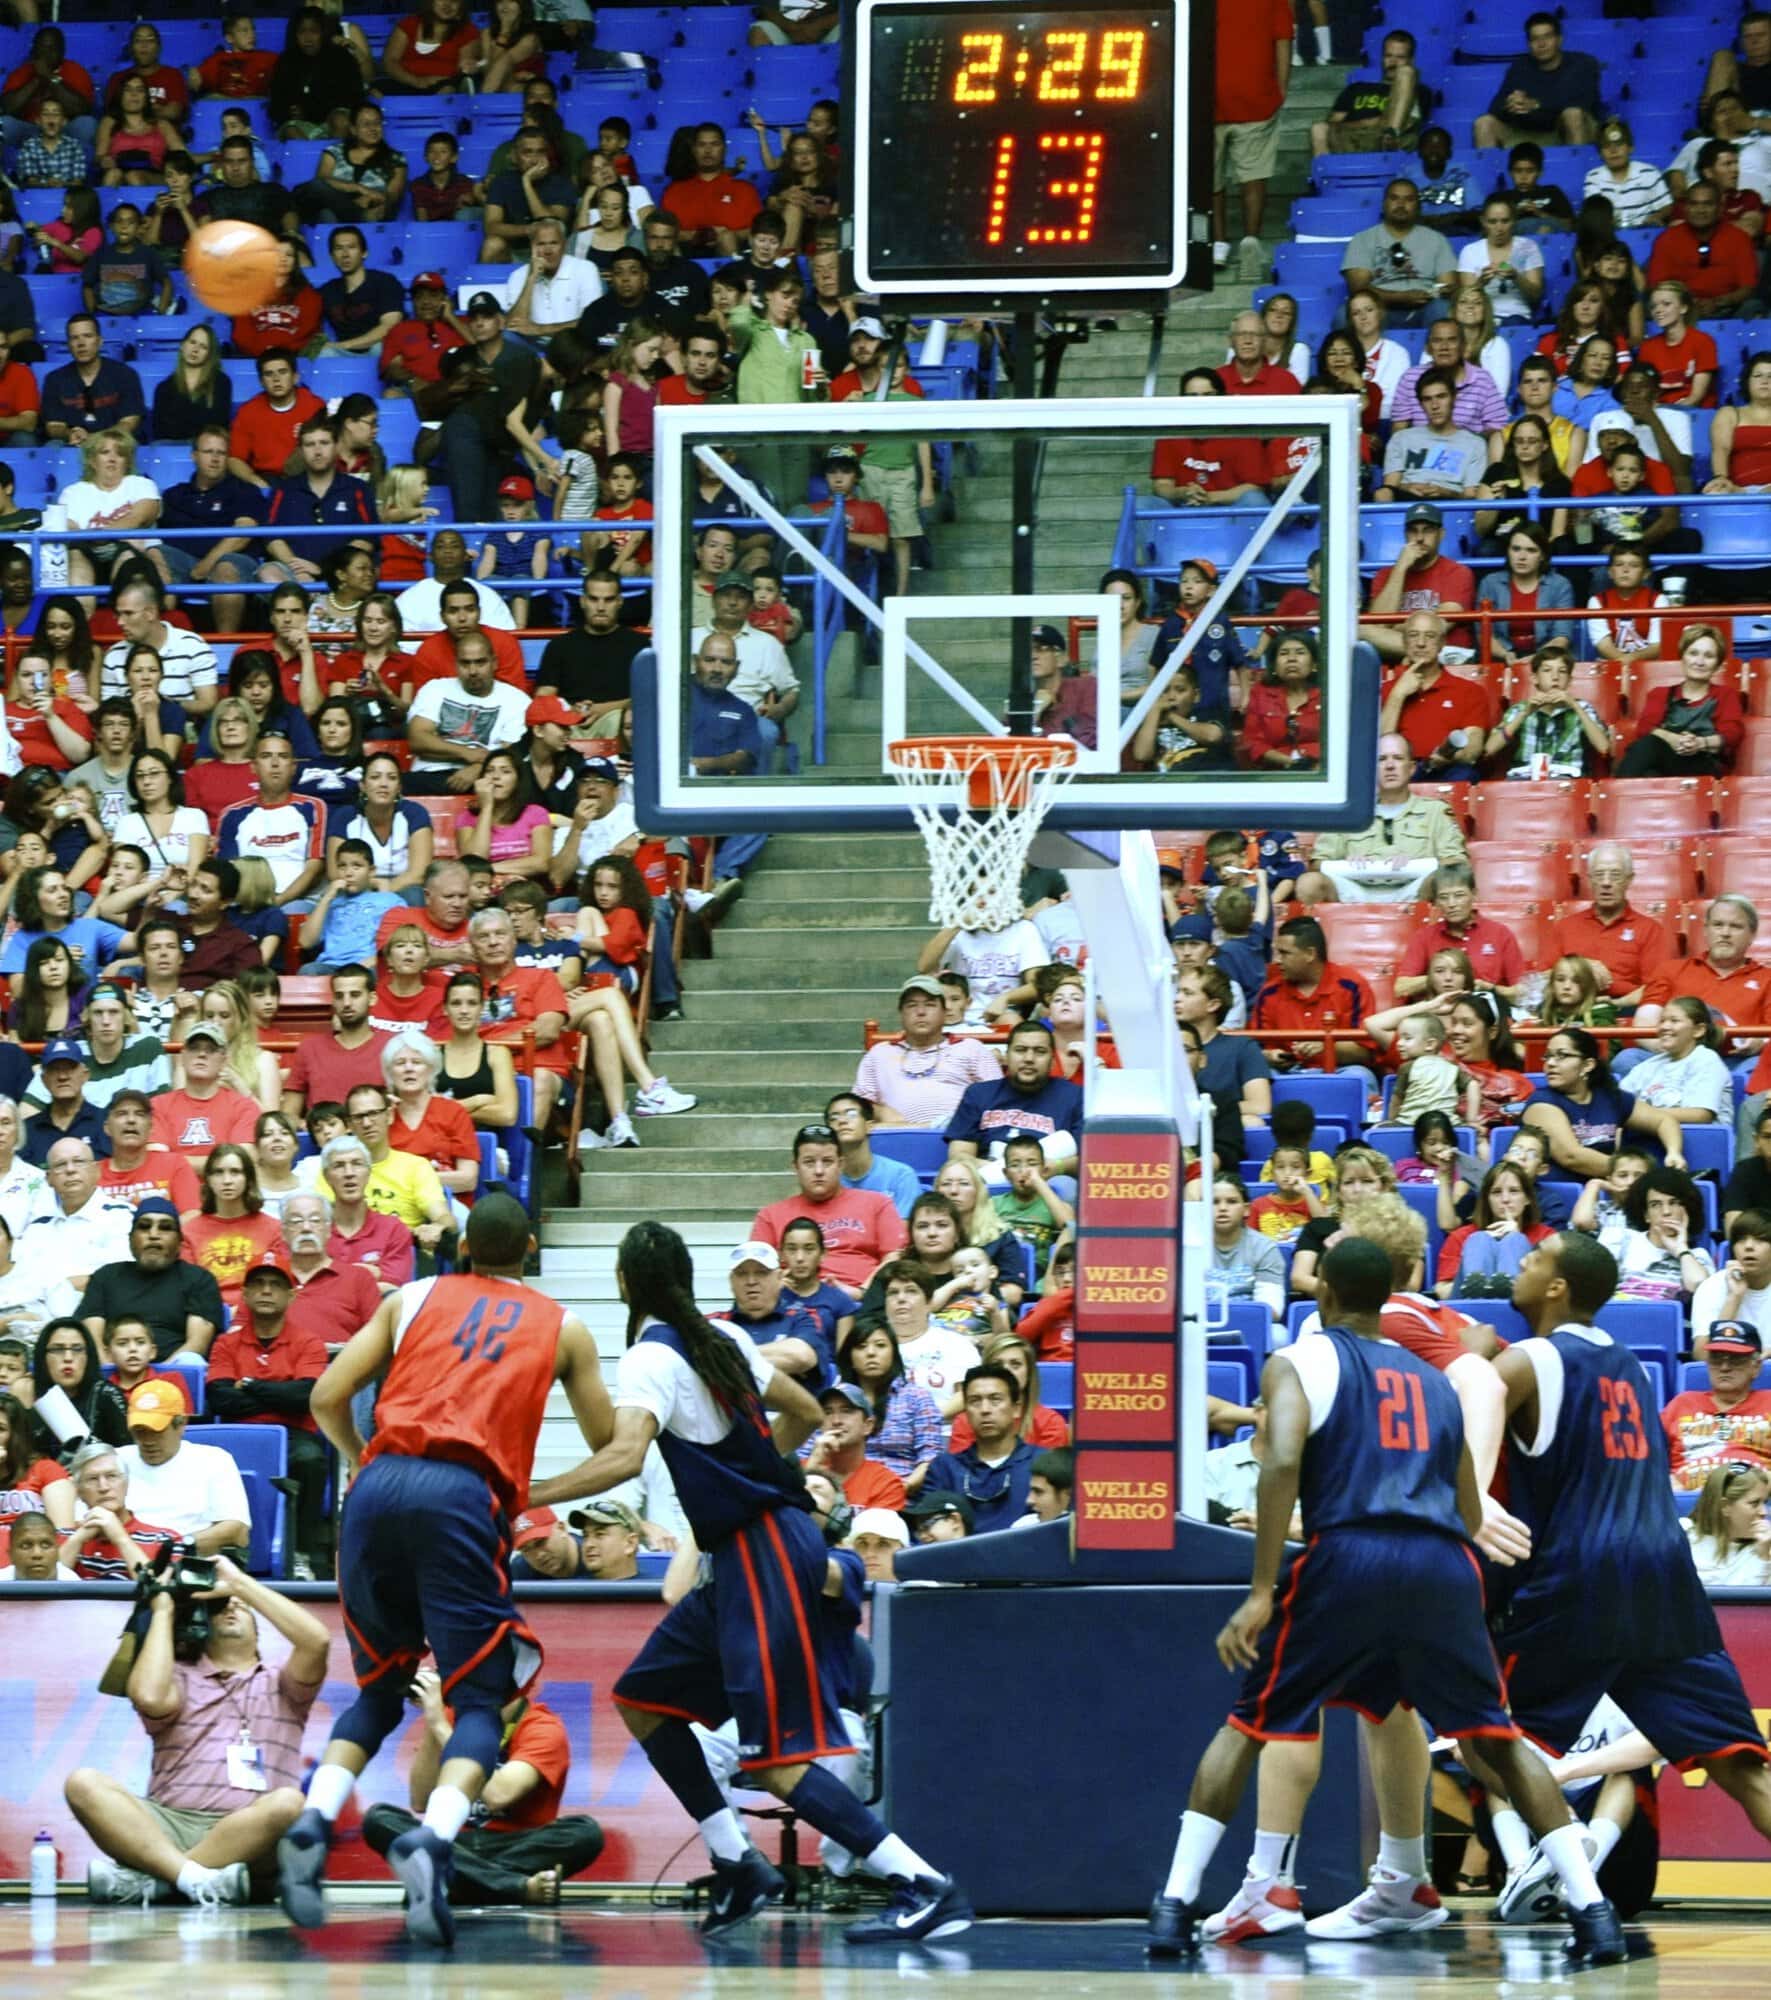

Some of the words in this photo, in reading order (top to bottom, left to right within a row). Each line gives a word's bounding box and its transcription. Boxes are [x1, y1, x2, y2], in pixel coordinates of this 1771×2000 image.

[954, 31, 1145, 102] 2:29
[988, 133, 1103, 244] 13
[980, 1108, 1055, 1134] ARIZONA
[177, 1116, 216, 1146] A
[1087, 1163, 1171, 1179] WELLS
[1088, 1183, 1169, 1199] FARGO
[1084, 1266, 1169, 1283] WELLS
[1085, 1287, 1167, 1303] FARGO
[451, 1295, 525, 1364] 42
[1082, 1372, 1168, 1390] WELLS
[1084, 1394, 1167, 1411] FARGO
[1375, 1367, 1429, 1452] 21
[1598, 1375, 1650, 1460] 23
[1082, 1481, 1168, 1499] WELLS
[1084, 1502, 1167, 1520] FARGO
